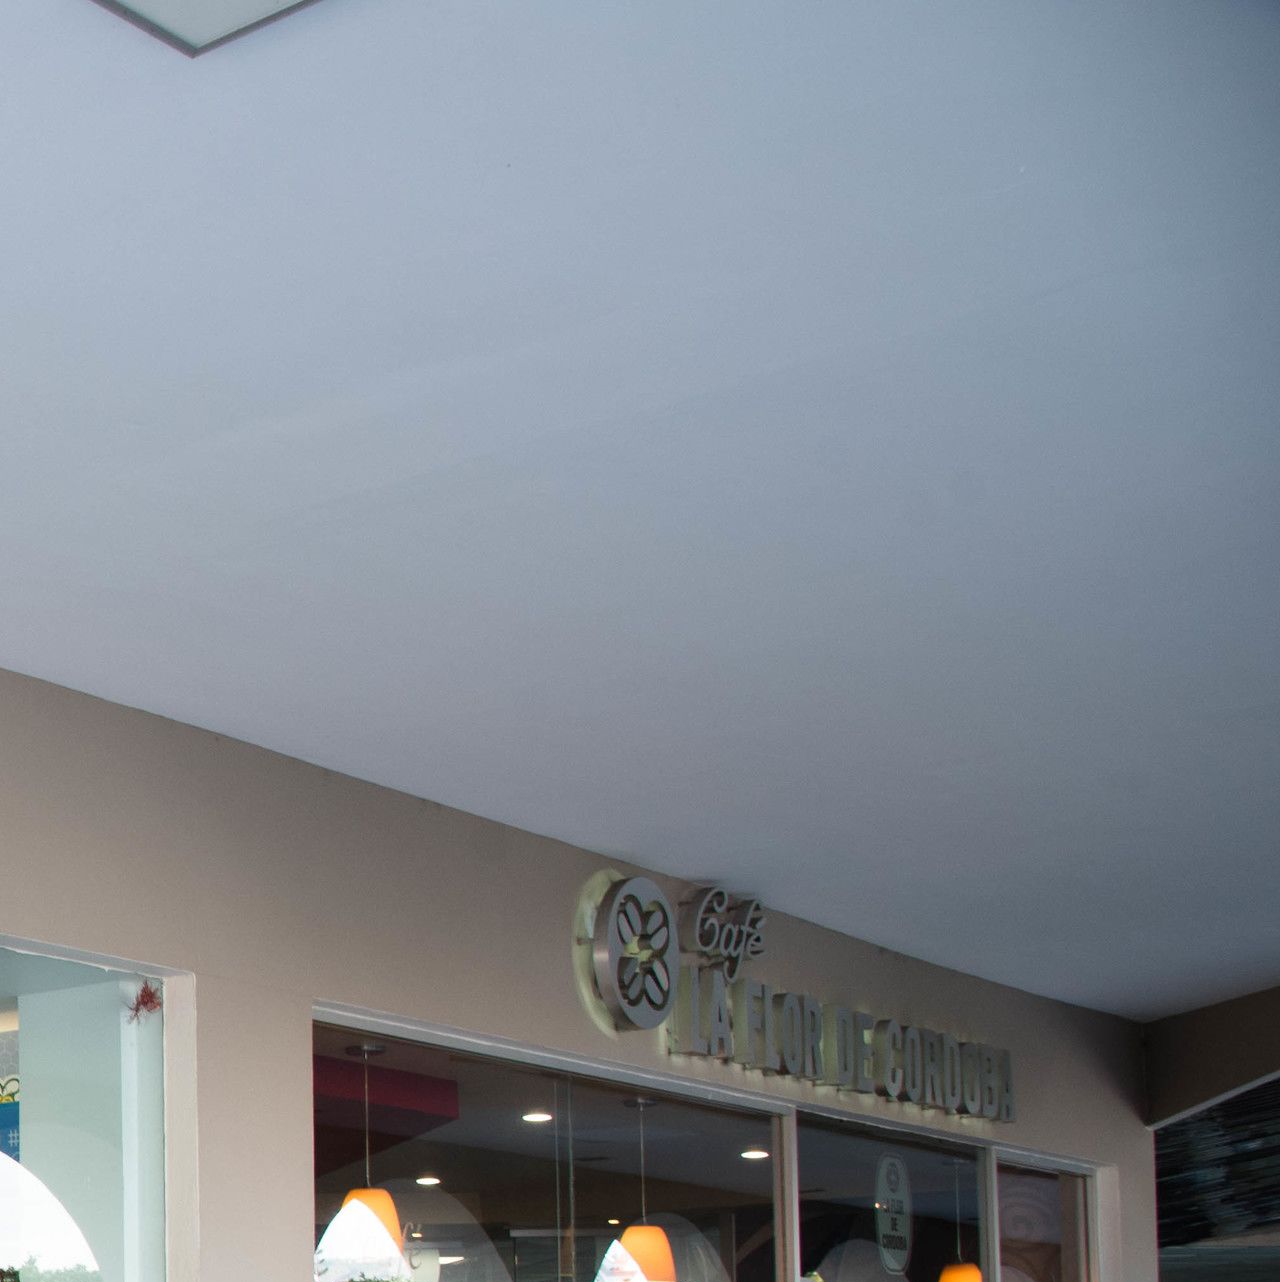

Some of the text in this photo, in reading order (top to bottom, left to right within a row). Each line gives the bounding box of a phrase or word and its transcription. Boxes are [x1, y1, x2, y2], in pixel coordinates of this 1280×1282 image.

[696, 886, 767, 984] Café
[680, 966, 1017, 1122] LA FLOR DE CORDOBA
